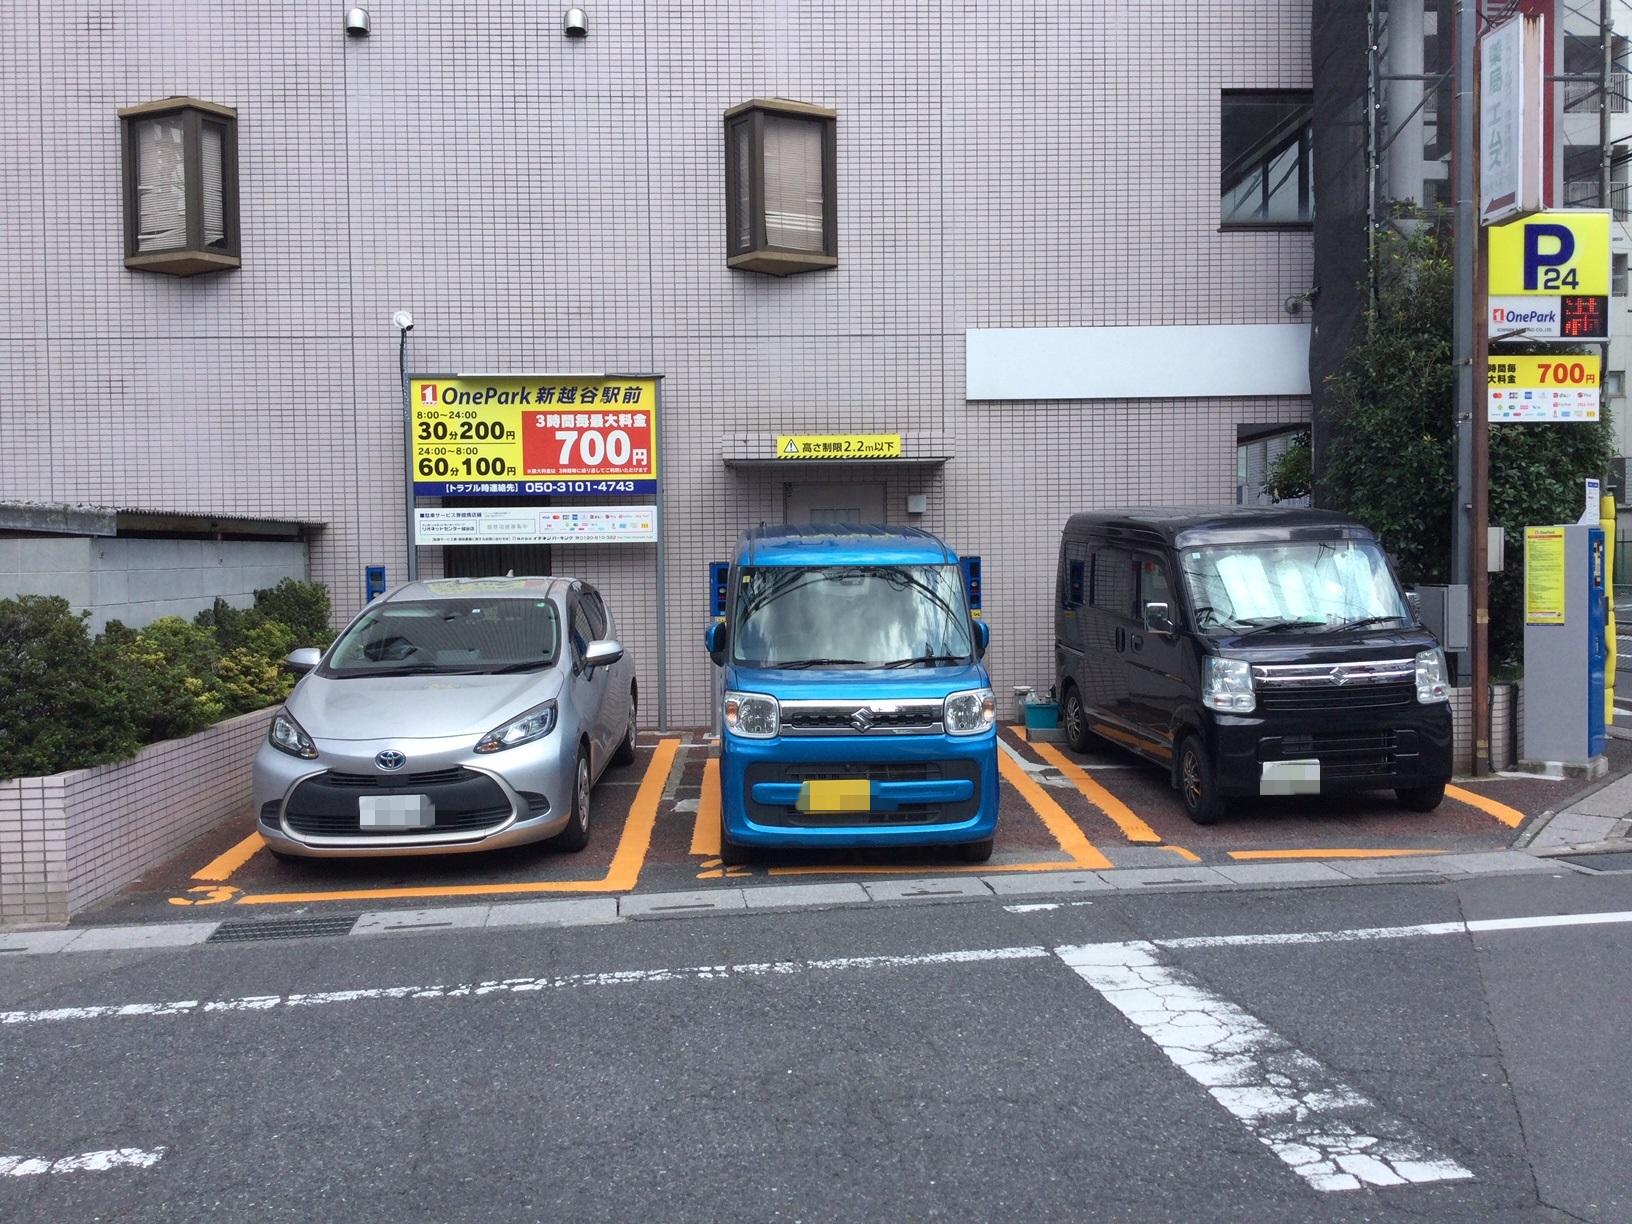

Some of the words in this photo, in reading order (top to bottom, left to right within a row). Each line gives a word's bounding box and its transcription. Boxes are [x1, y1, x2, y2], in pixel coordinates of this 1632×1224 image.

[1523, 224, 1575, 290] P
[1543, 268, 1579, 290] 24
[1506, 310, 1555, 324] OnePark
[1488, 374, 1516, 384] 大料金
[1537, 363, 1595, 384] 700円
[442, 386, 532, 405] OnePark
[535, 386, 643, 405] 新越谷駅前
[536, 413, 647, 428] 3時間毎最大料金
[555, 429, 648, 466] 700円
[802, 441, 894, 453] 高さ制限2.2m以下
[525, 481, 634, 493] 050-3101-4743
